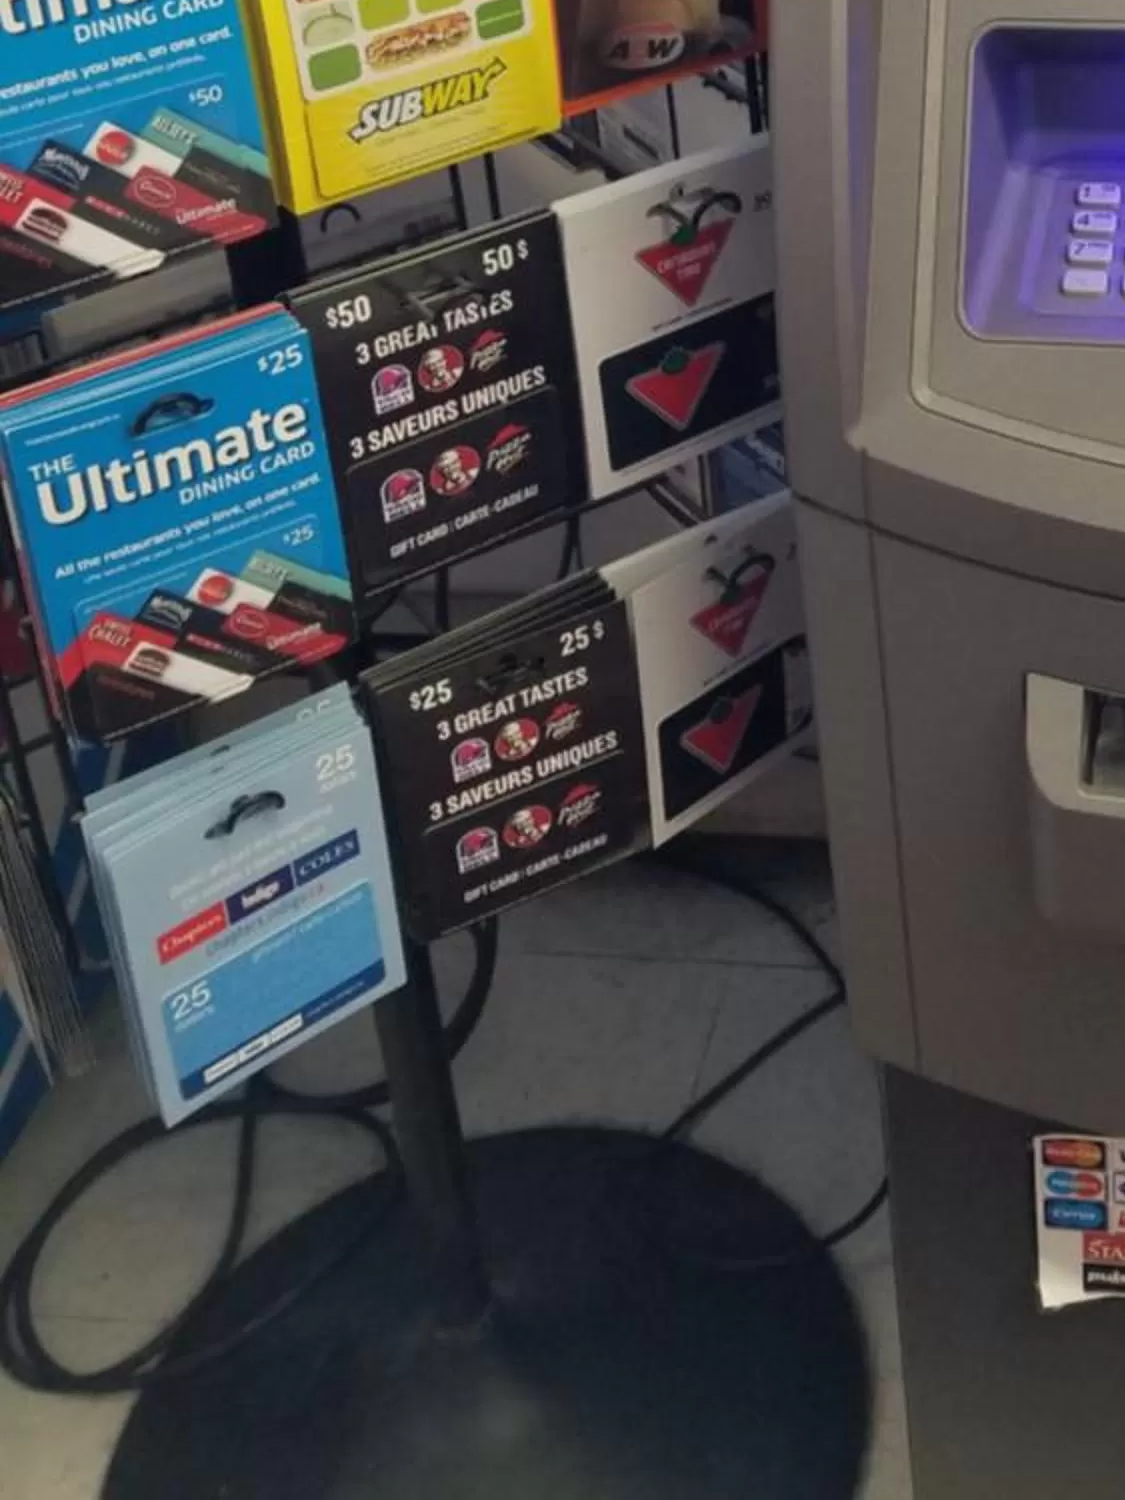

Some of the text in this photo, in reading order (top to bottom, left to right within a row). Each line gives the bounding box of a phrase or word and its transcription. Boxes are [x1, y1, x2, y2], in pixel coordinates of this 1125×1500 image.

[73, 5, 158, 45] DINING
[80, 59, 110, 80] you
[169, 36, 197, 53] one
[188, 84, 223, 107] $50
[348, 57, 507, 144] SUBWAY
[1076, 213, 1090, 227] 4
[481, 238, 529, 276] 50 $
[1073, 242, 1086, 256] 7
[326, 294, 373, 329] $50
[257, 343, 304, 376] $25
[355, 343, 371, 365] 3
[350, 435, 365, 459] 3
[367, 399, 460, 452] SAVEURS
[462, 364, 547, 415] UNIQUES
[28, 453, 77, 482] THE
[37, 402, 309, 525] Ultimate
[178, 440, 316, 506] DINING CARD
[55, 561, 75, 580] All
[77, 556, 102, 573] the
[104, 528, 184, 564] restaurants
[282, 524, 314, 547] $25
[560, 619, 605, 657] 25 $
[408, 678, 453, 712] $25
[436, 720, 452, 741] 3
[454, 697, 518, 734] GREAT
[518, 666, 590, 708] TASTES
[315, 743, 355, 781] 25
[429, 801, 444, 821] 3
[447, 765, 534, 815] SAVEURS
[537, 729, 618, 779] UNIQUES
[170, 979, 212, 1021] 25
